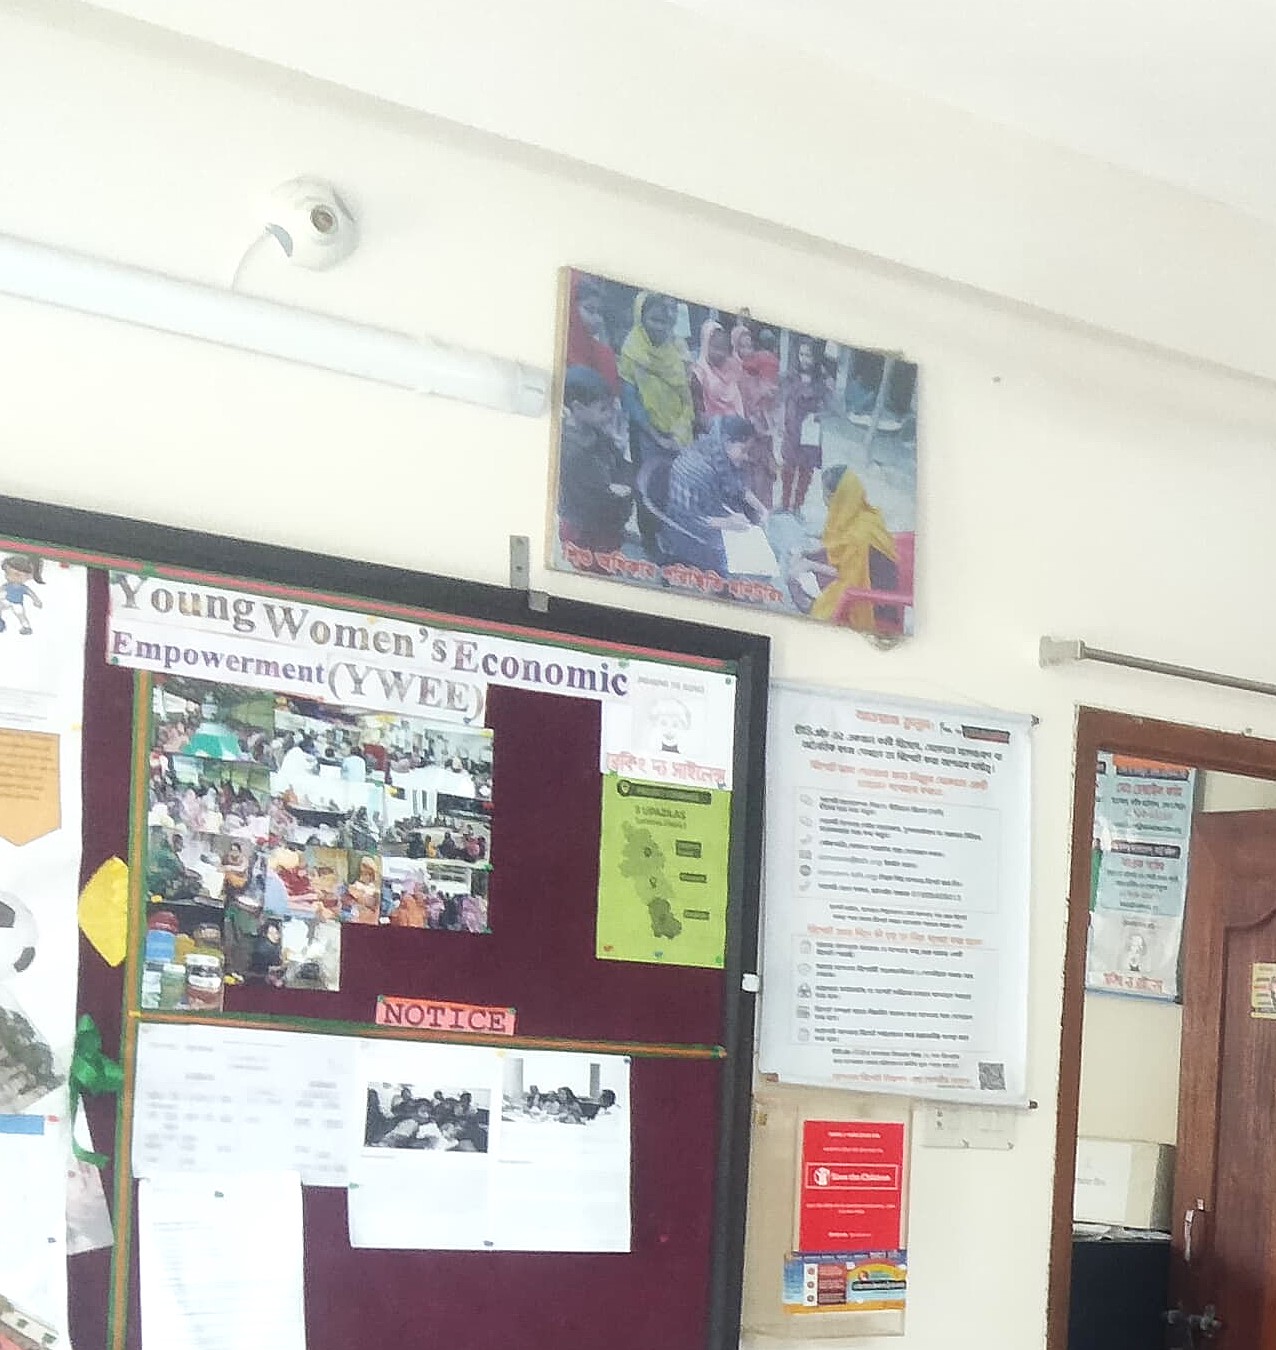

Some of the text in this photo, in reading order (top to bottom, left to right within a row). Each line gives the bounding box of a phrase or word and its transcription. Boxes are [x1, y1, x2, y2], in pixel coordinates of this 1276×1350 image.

[112, 629, 484, 718] Empowerment (YWEE)
[113, 573, 256, 633] Young
[452, 639, 629, 697] Economic
[384, 1002, 505, 1032] NOTICE
